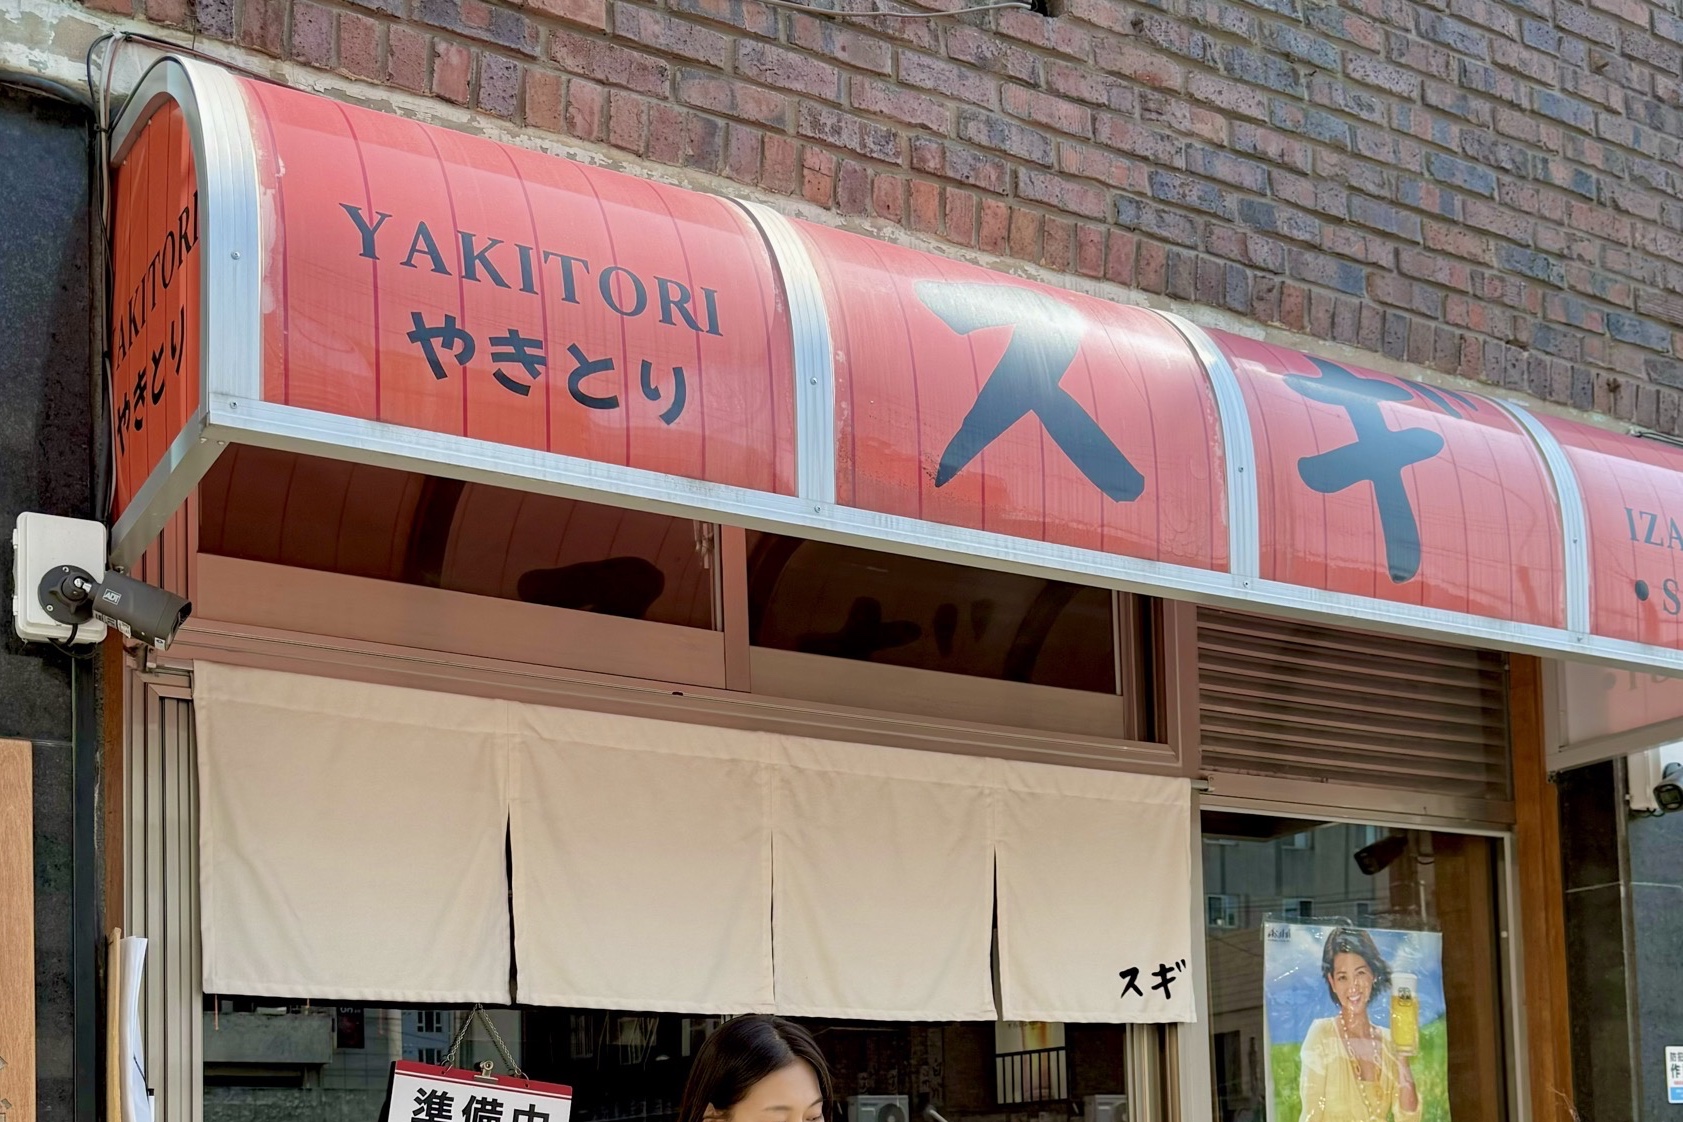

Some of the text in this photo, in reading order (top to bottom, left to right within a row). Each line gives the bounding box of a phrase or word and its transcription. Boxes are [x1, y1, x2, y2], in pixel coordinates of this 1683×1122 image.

[112, 190, 199, 371] AKITORI
[339, 202, 724, 337] YAKITORI
[117, 304, 185, 457] やきとり
[406, 311, 687, 426] やきとり
[103, 591, 121, 603] ADT
[1118, 958, 1187, 1000] スギ
